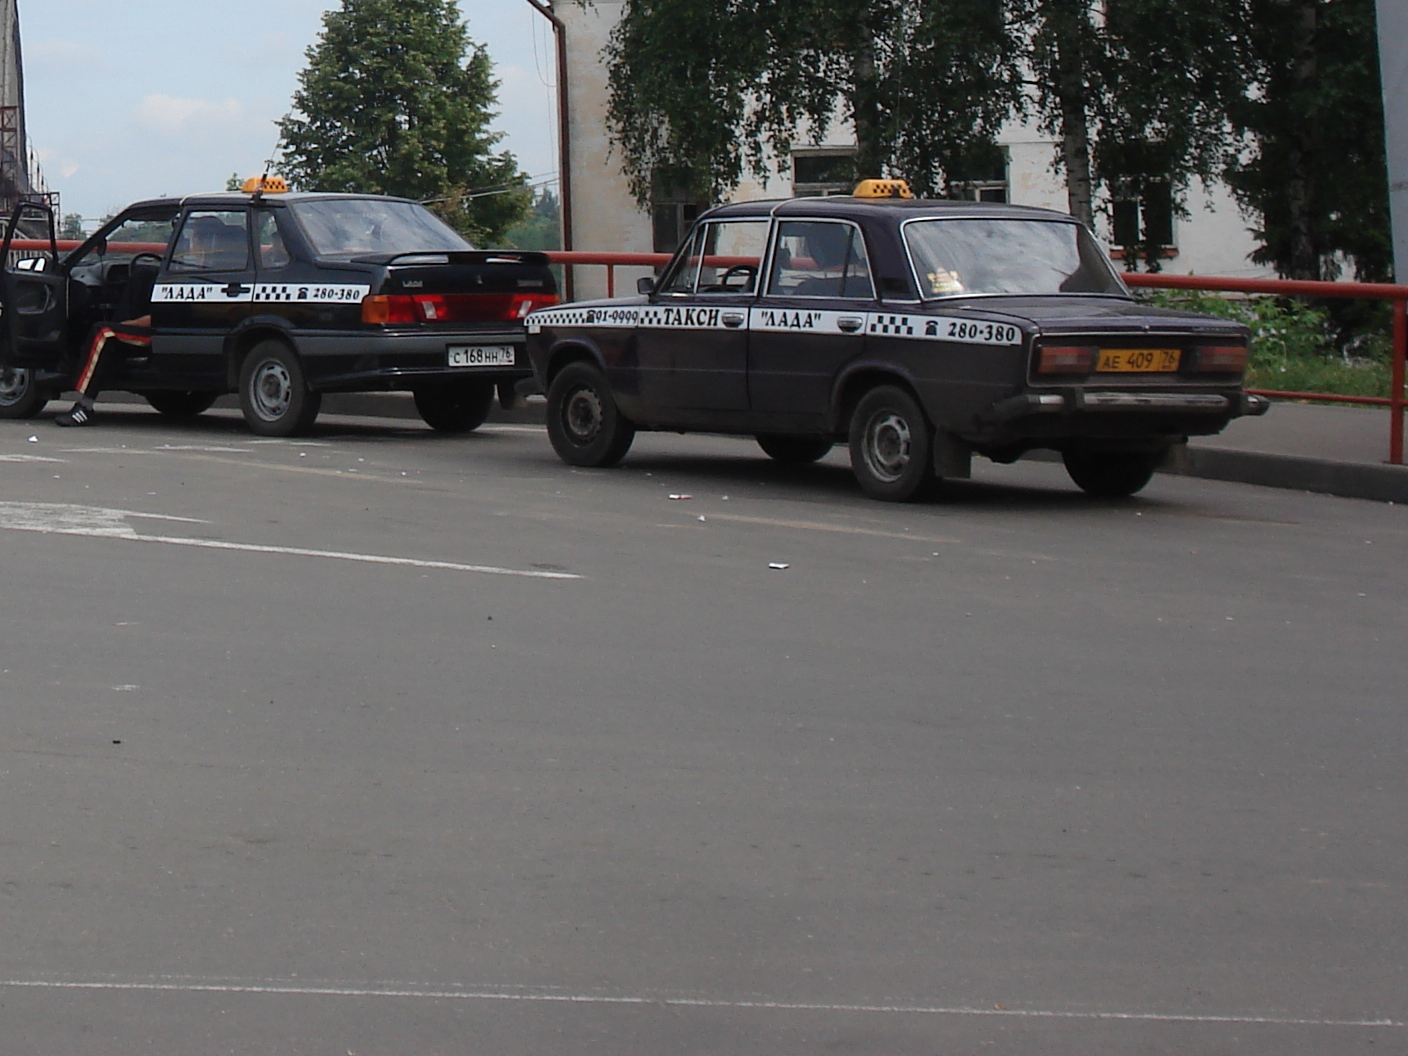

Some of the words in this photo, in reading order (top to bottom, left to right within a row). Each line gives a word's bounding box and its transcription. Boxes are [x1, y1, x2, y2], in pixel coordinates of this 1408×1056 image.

[162, 287, 212, 301] "ЛАДА"
[313, 288, 360, 300] 280-380
[664, 308, 720, 327] ТАКСИ
[761, 311, 821, 329] "ЛАДА"
[947, 322, 1015, 342] 280-380
[1127, 352, 1153, 368] 409
